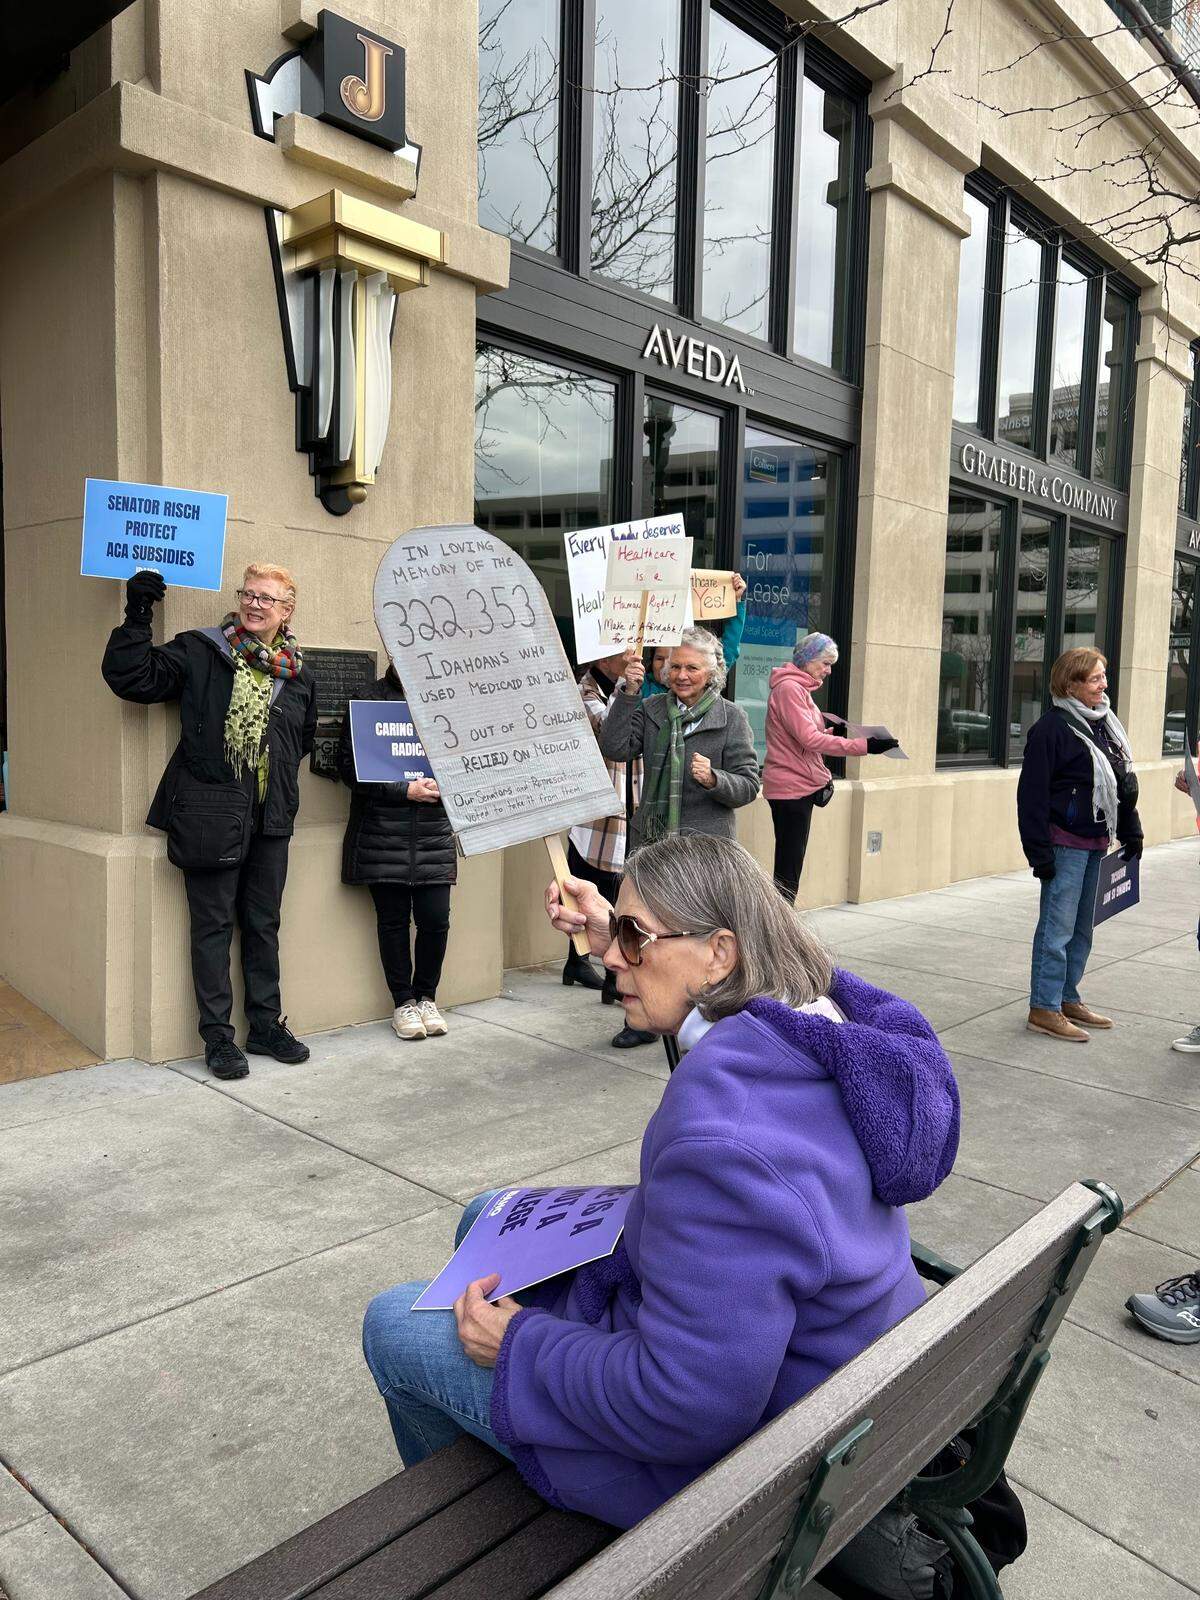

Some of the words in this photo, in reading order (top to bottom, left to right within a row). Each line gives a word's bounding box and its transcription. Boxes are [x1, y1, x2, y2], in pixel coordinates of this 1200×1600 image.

[340, 33, 393, 122] J
[643, 323, 746, 393] AVEDA
[962, 443, 1037, 494] GRAEBER
[1040, 476, 1049, 498] &
[1052, 476, 1118, 521] COMPANY
[107, 495, 160, 516] SENATOR
[163, 500, 201, 520] RISCH
[125, 520, 178, 541] PROTECT
[568, 533, 607, 560] Every
[643, 520, 682, 539] deserves
[106, 542, 129, 559] ACA
[132, 544, 195, 567] SUBSIDIES
[402, 544, 429, 561] IN
[440, 541, 495, 557] LOVING
[618, 545, 678, 561] Healthcare
[746, 543, 773, 571] For
[392, 563, 456, 584] MEMORY
[466, 560, 484, 573] OF
[491, 557, 514, 568] THE
[636, 568, 644, 581] is
[654, 573, 663, 581] a
[692, 586, 726, 618] Yes!
[745, 576, 790, 605] Lease
[383, 585, 536, 648] 322,353
[603, 618, 625, 631] Make
[628, 621, 636, 631] it
[417, 651, 510, 680] IDAHOANS
[518, 646, 545, 660] WHO
[419, 687, 456, 703] USED
[468, 679, 523, 697] MEDICAID
[526, 675, 541, 687] IN
[544, 669, 569, 684] 2024
[375, 722, 413, 737] CARING
[433, 714, 459, 749] 3
[470, 725, 495, 741] OUT
[501, 723, 516, 734] OF
[523, 703, 538, 730] 8
[542, 711, 586, 726] CHILDREN
[391, 742, 426, 757] RADIC
[461, 751, 509, 774] RELIED
[513, 749, 530, 763] ON
[453, 793, 474, 807] Our
[494, 804, 503, 813] to
[540, 793, 559, 802] from
[581, 1198, 619, 1217] IS
[535, 1211, 568, 1231] A
[569, 1217, 604, 1237] A
